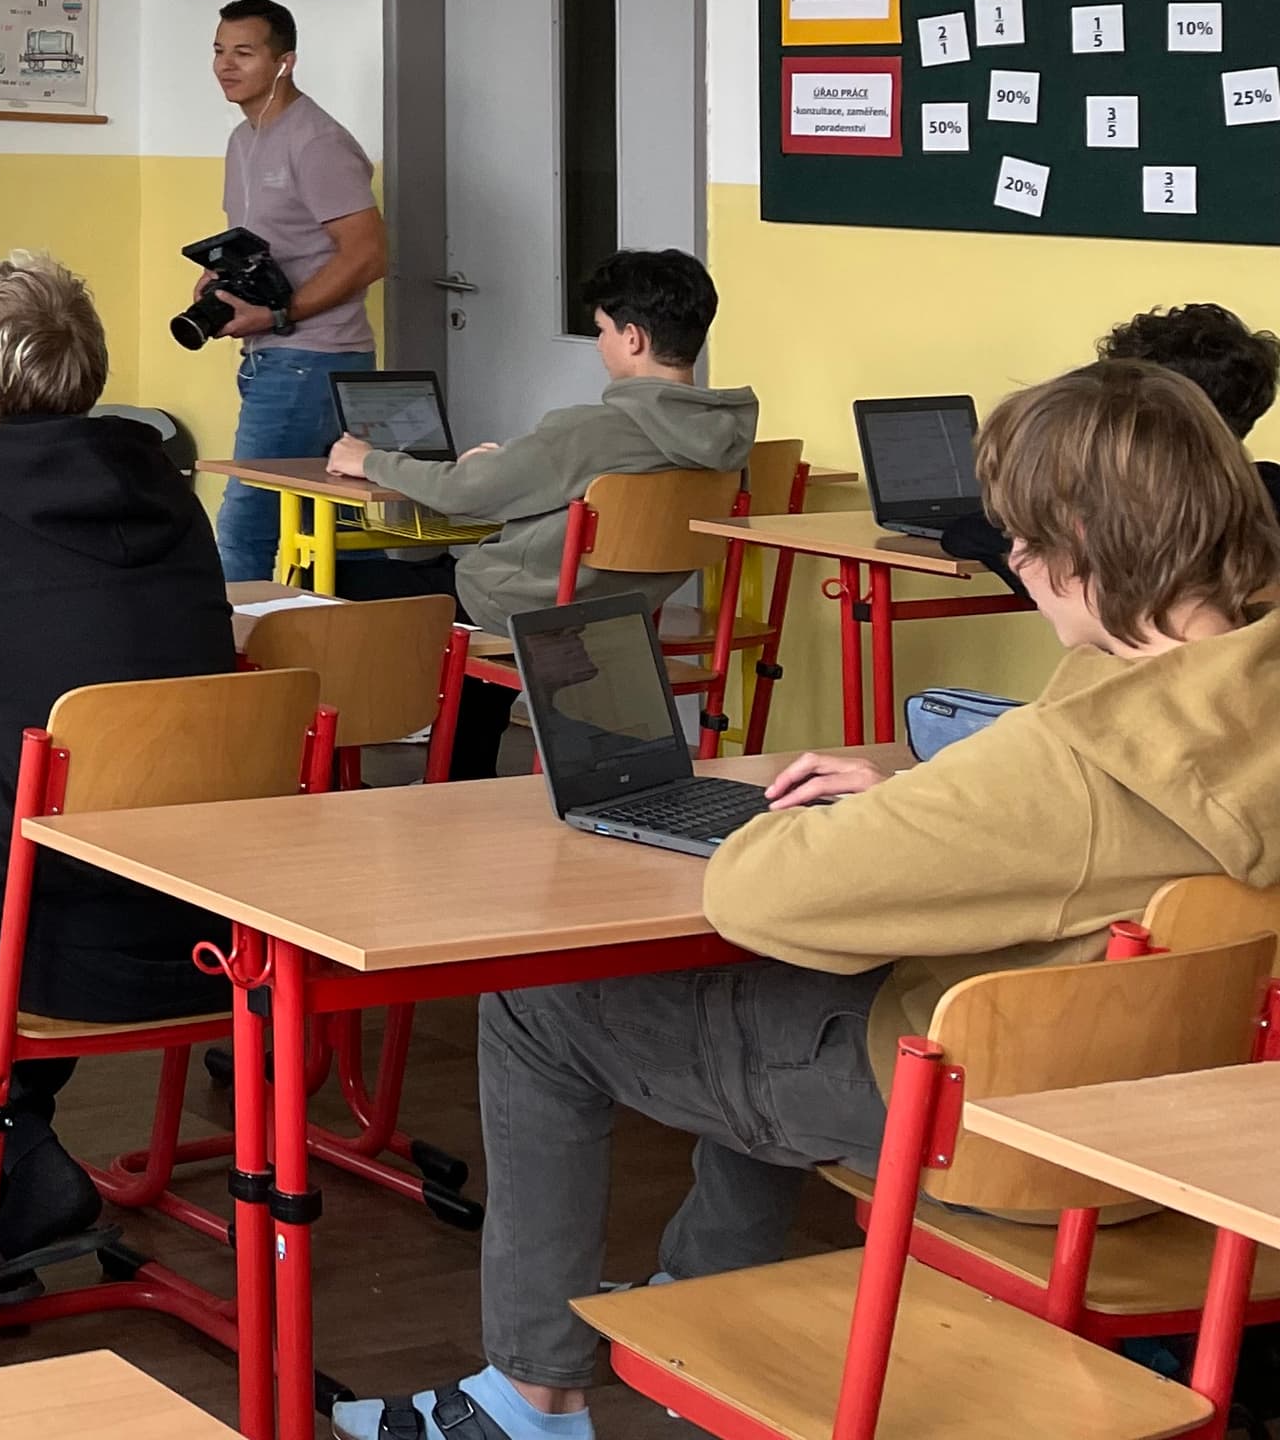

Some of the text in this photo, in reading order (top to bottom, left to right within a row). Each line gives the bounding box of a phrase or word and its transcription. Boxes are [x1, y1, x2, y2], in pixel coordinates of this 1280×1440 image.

[995, 7, 1002, 19] 1
[995, 23, 1005, 35] 4
[1093, 17, 1101, 30] 1
[1177, 21, 1213, 35] 10%
[938, 26, 947, 39] 2
[1093, 34, 1103, 47] 5
[940, 42, 947, 55] 1
[997, 89, 1030, 105] 90%
[1232, 89, 1272, 106] 25%
[1107, 108, 1115, 120] 3
[929, 121, 961, 134] 50%
[1107, 124, 1116, 137] 5
[1165, 172, 1173, 185] 3
[1004, 177, 1038, 197] 20%
[1164, 190, 1174, 203] 2
